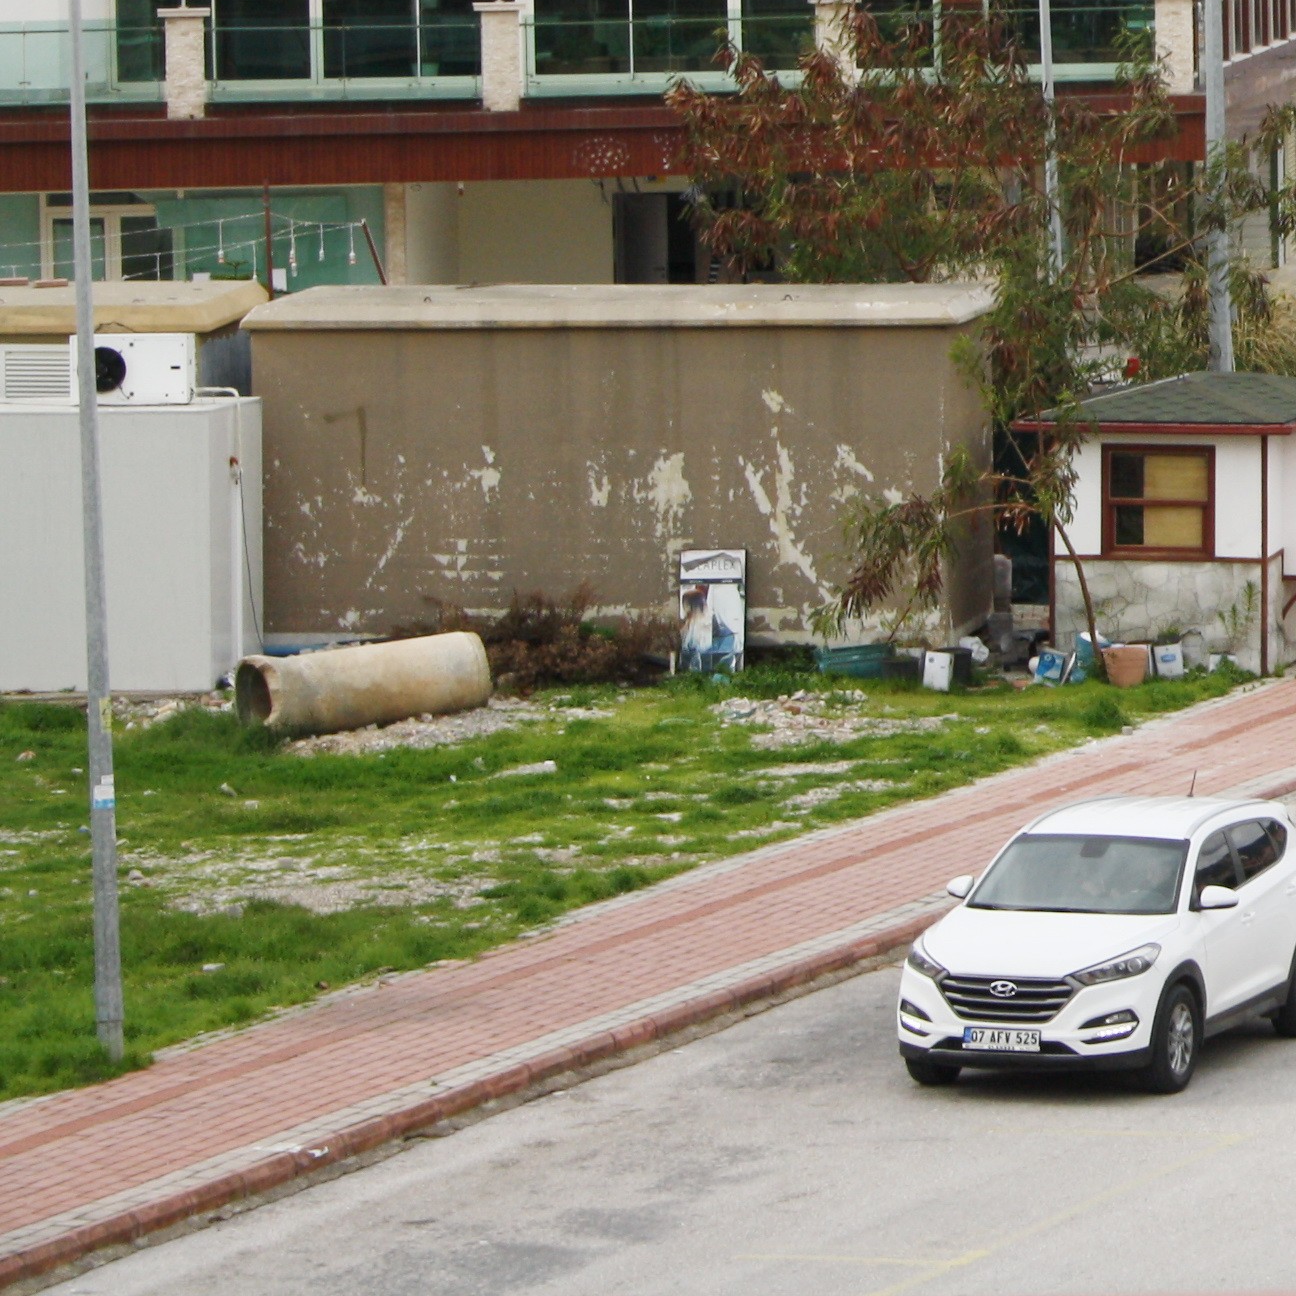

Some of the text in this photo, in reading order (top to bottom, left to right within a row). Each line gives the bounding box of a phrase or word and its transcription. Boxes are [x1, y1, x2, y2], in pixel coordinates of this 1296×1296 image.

[971, 1030, 1038, 1045] 07 AFV 525
